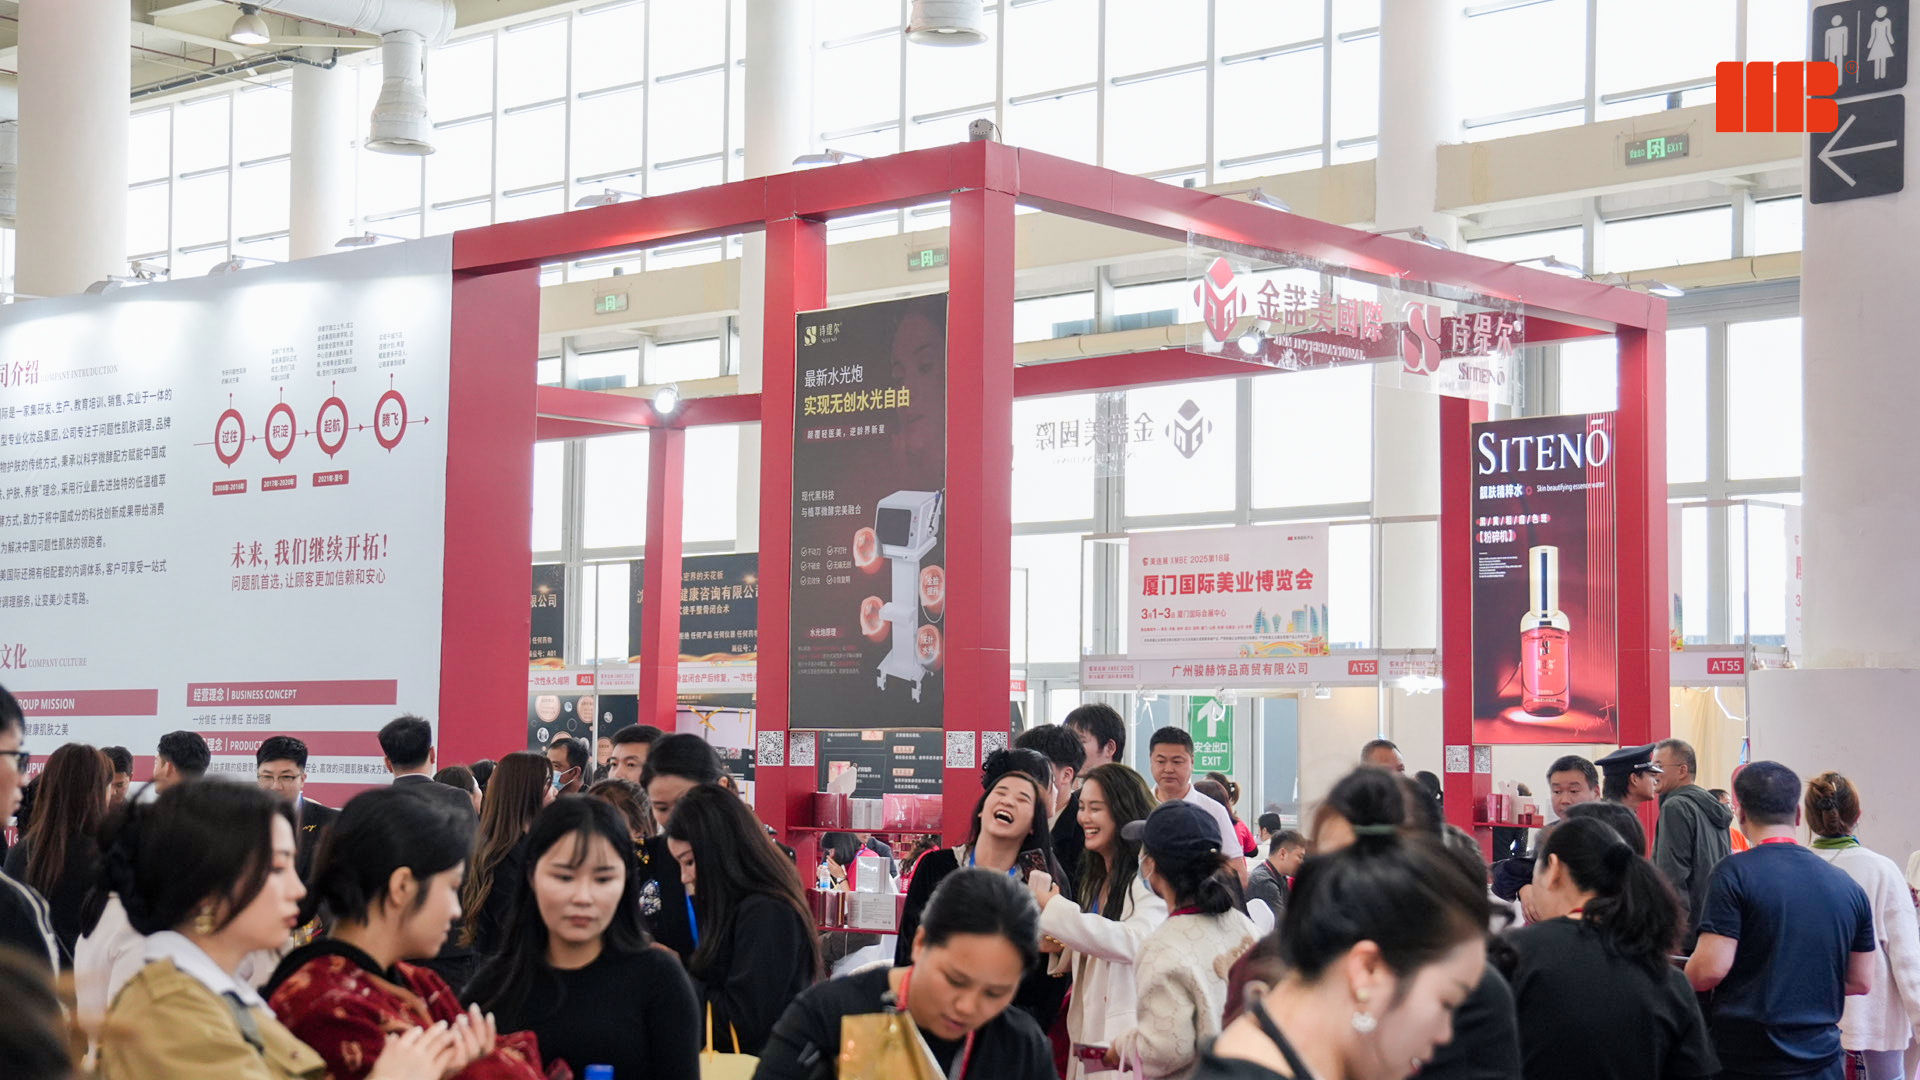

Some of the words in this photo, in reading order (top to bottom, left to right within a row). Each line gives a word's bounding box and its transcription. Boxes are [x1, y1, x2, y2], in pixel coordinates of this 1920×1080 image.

[804, 364, 864, 388] 最新水光炮
[0, 388, 172, 420] 际是一家集研发、生产、教育培训、销售、实业于一体的
[804, 386, 910, 416] 实现无创水光自由
[382, 412, 399, 427] 腾飞
[222, 429, 238, 444] 过往
[1142, 567, 1314, 596] 厦门国际美业博览会
[28, 658, 58, 668] COMPANY
[59, 657, 87, 667] CULTURE
[1351, 663, 1375, 673] AT55
[1712, 660, 1741, 671] AT55
[1171, 662, 1309, 679] 广州骏赫饰品商贸有限公司
[231, 689, 264, 701] BUSINESS
[264, 688, 298, 700] CONCEPT
[40, 698, 75, 710] MISSION
[1193, 742, 1228, 753] 安全出口
[1202, 755, 1222, 766] EXIT
